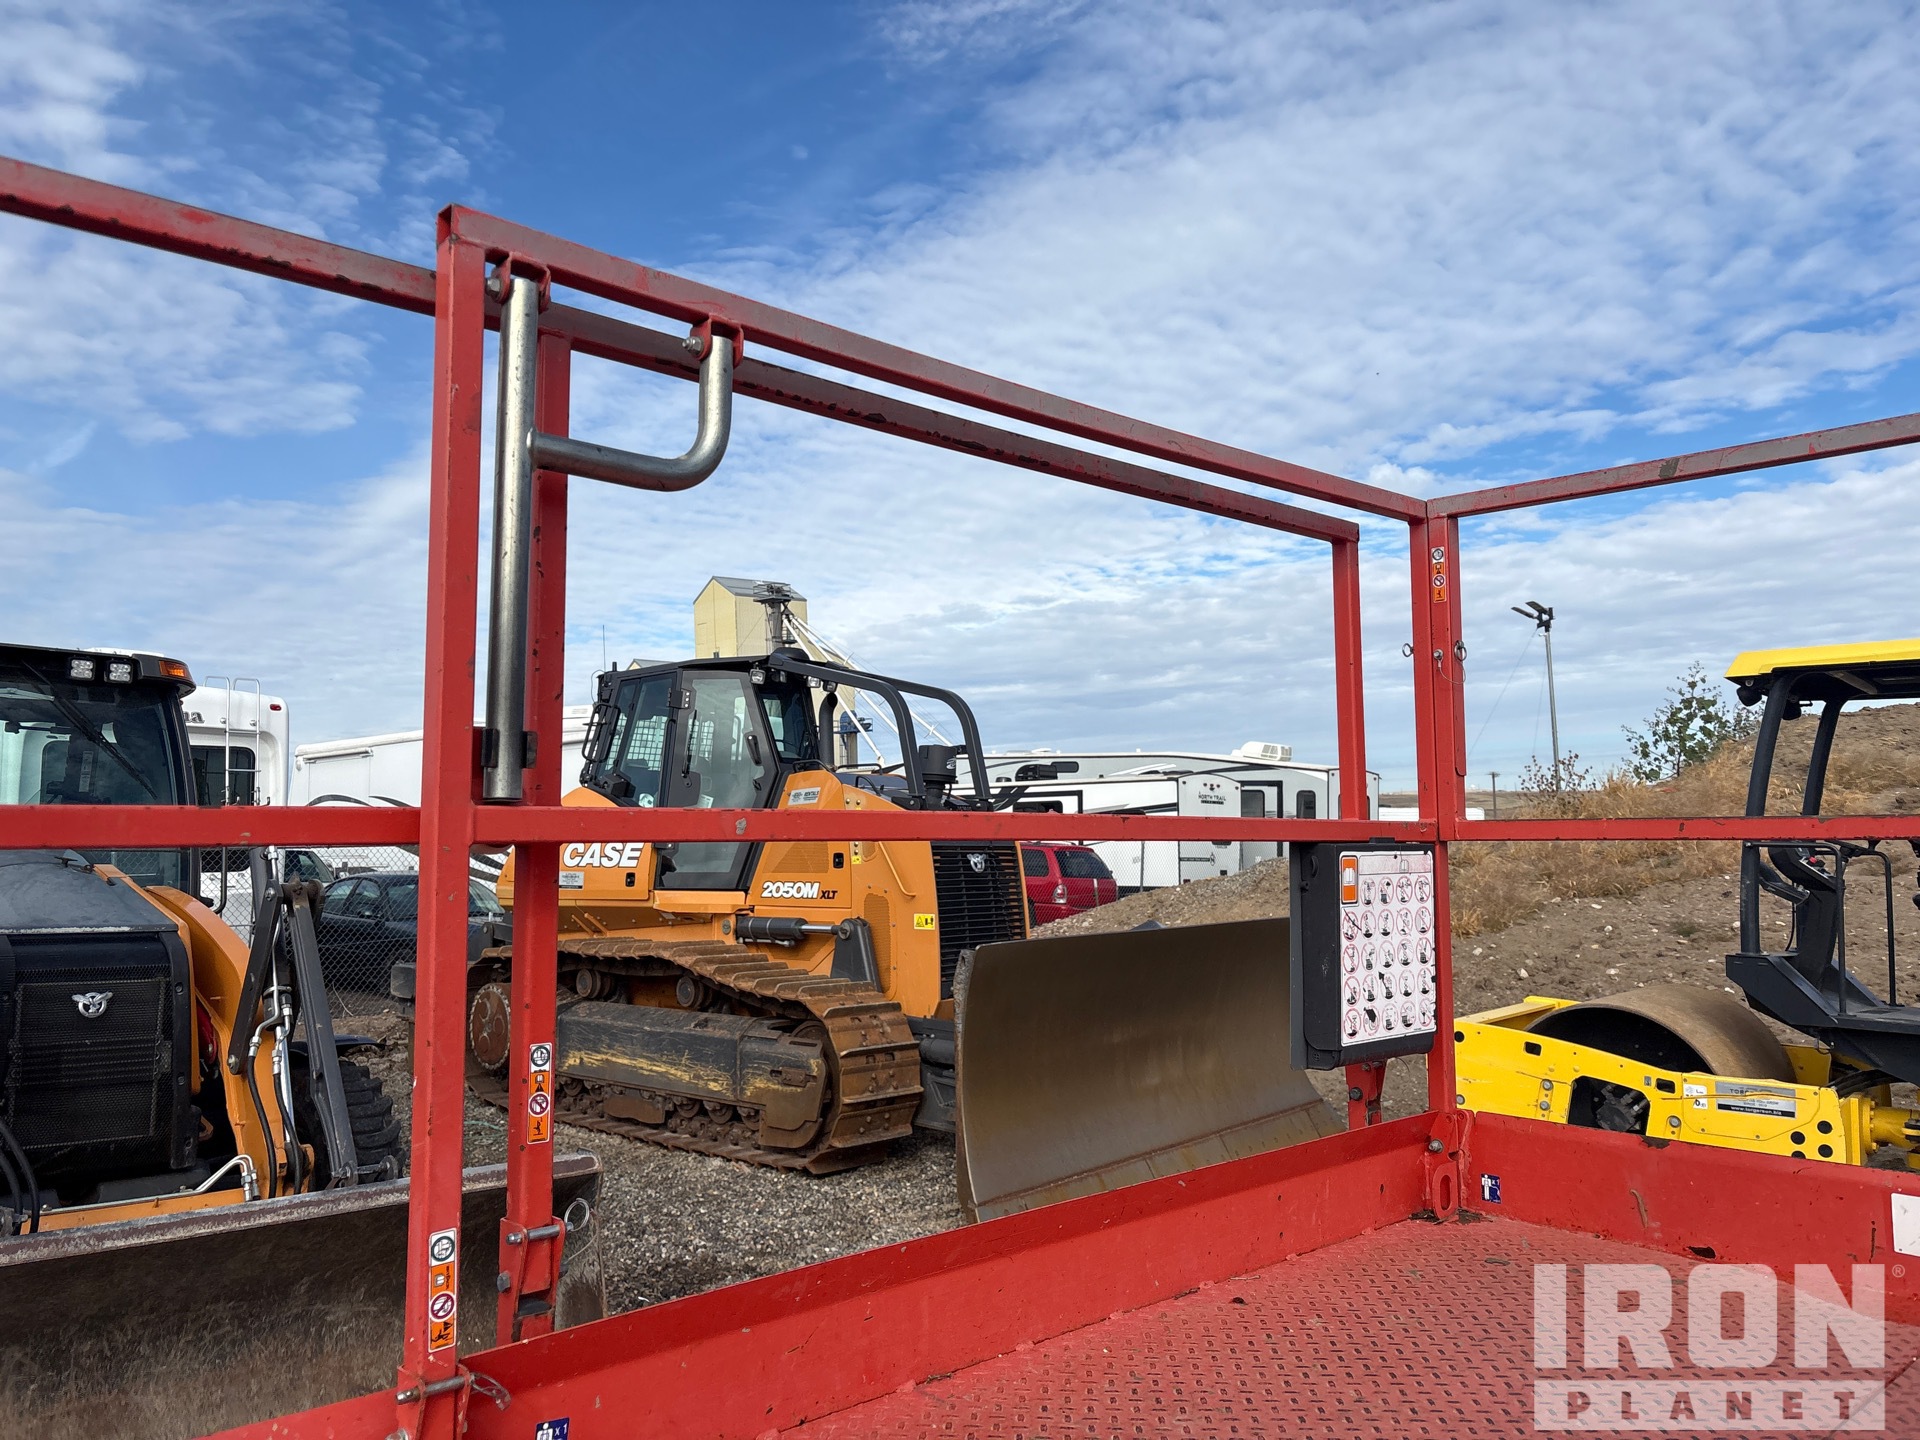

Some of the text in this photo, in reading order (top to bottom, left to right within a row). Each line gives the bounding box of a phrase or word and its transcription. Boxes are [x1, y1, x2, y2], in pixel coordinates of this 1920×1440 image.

[563, 842, 645, 868] CASE
[761, 881, 838, 900] 2050M XLT
